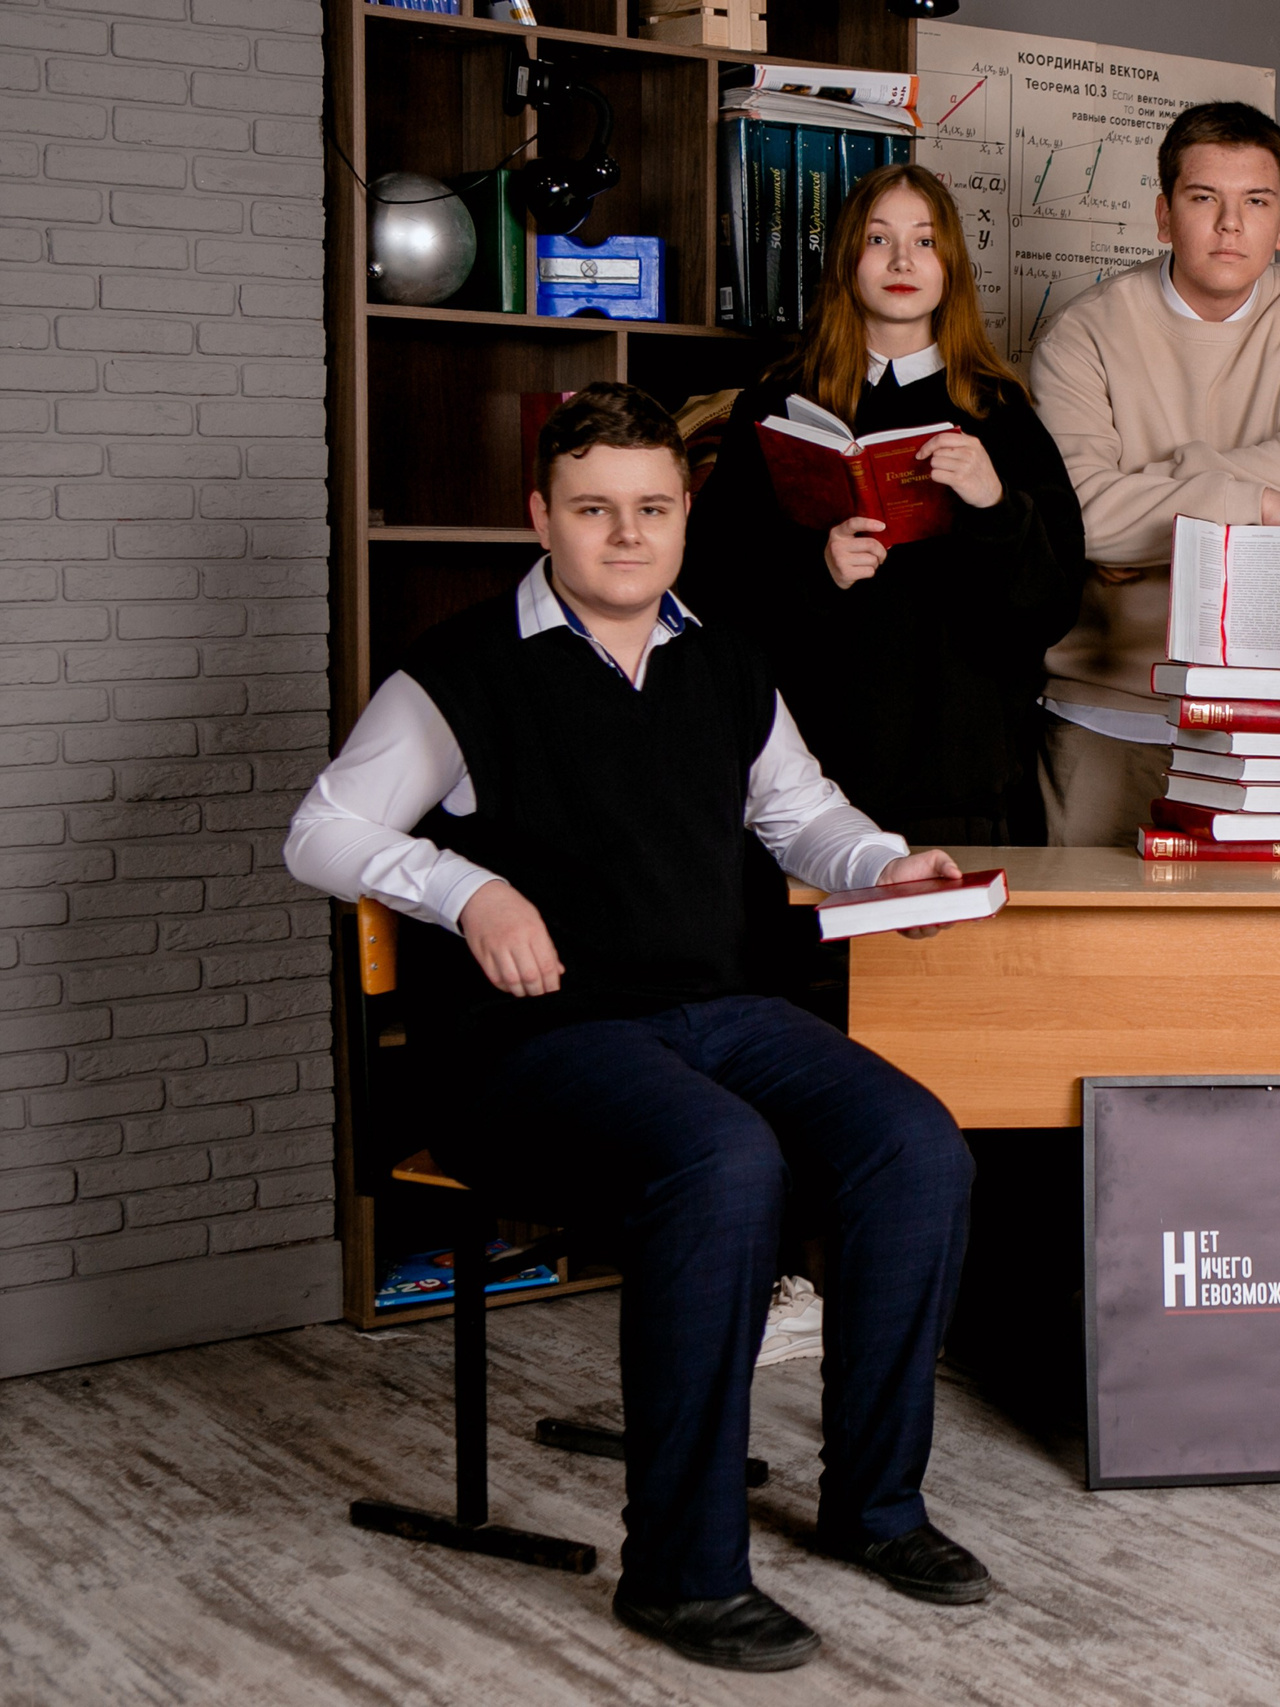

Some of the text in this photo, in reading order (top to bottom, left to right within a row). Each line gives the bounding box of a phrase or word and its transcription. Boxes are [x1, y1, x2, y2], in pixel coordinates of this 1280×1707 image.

[1018, 52, 1160, 82] КООРДИНАТЫ ВЕКТОРА
[1025, 77, 1080, 95] Теорема
[1084, 83, 1107, 98] 10.3
[1137, 94, 1176, 107] векторы
[1138, 107, 1155, 117] они
[1072, 111, 1173, 131] равные соответствую
[1015, 250, 1142, 266] равные соответствующие
[1114, 245, 1154, 256] векторы
[900, 473, 932, 485] вечно
